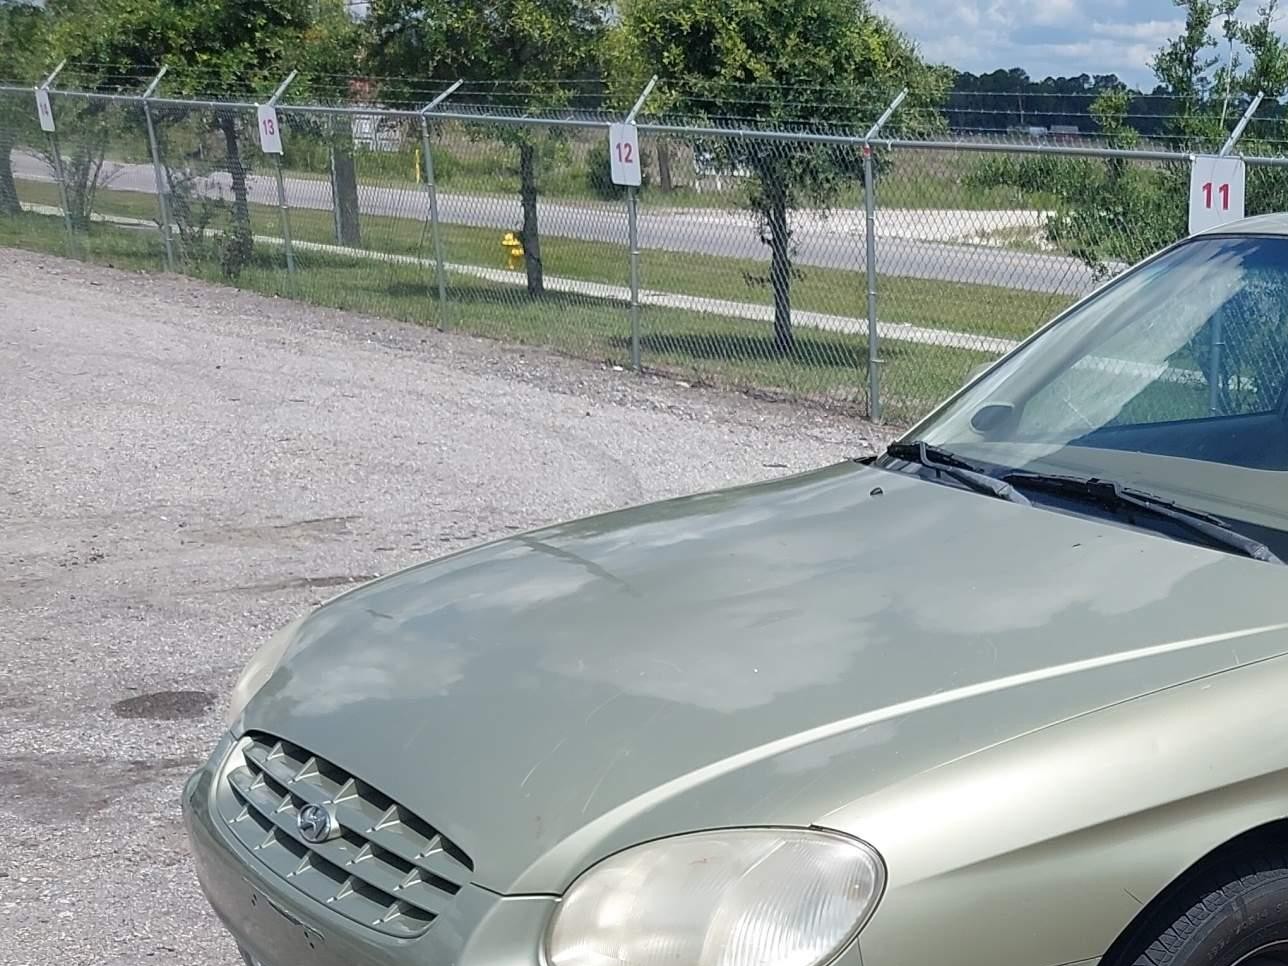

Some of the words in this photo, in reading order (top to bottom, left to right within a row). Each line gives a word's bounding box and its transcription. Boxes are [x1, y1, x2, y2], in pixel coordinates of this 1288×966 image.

[262, 119, 275, 136] 13
[615, 142, 633, 163] 12
[1202, 182, 1229, 211] 11
